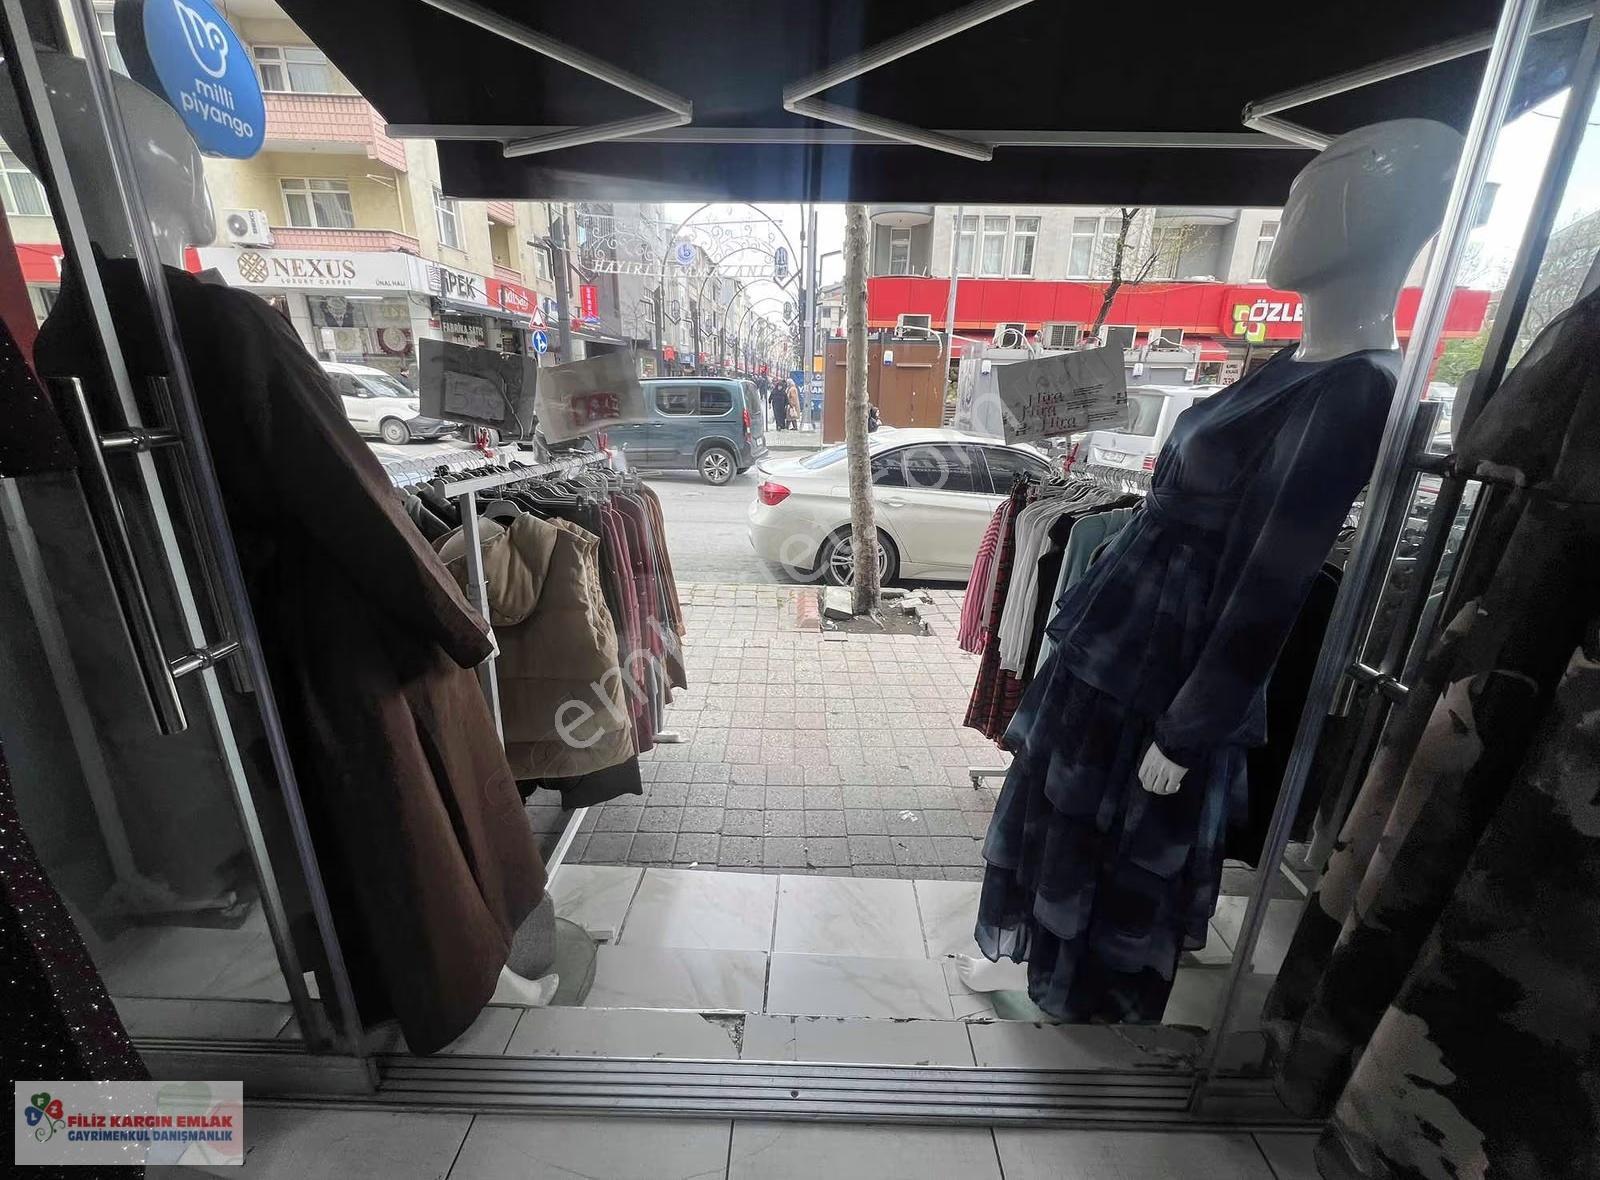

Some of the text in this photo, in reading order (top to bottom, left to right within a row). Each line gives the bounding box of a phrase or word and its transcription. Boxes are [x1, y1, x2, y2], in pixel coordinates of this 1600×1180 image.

[194, 78, 235, 110] milli
[180, 90, 254, 138] piyango
[271, 257, 356, 279] NEXUS
